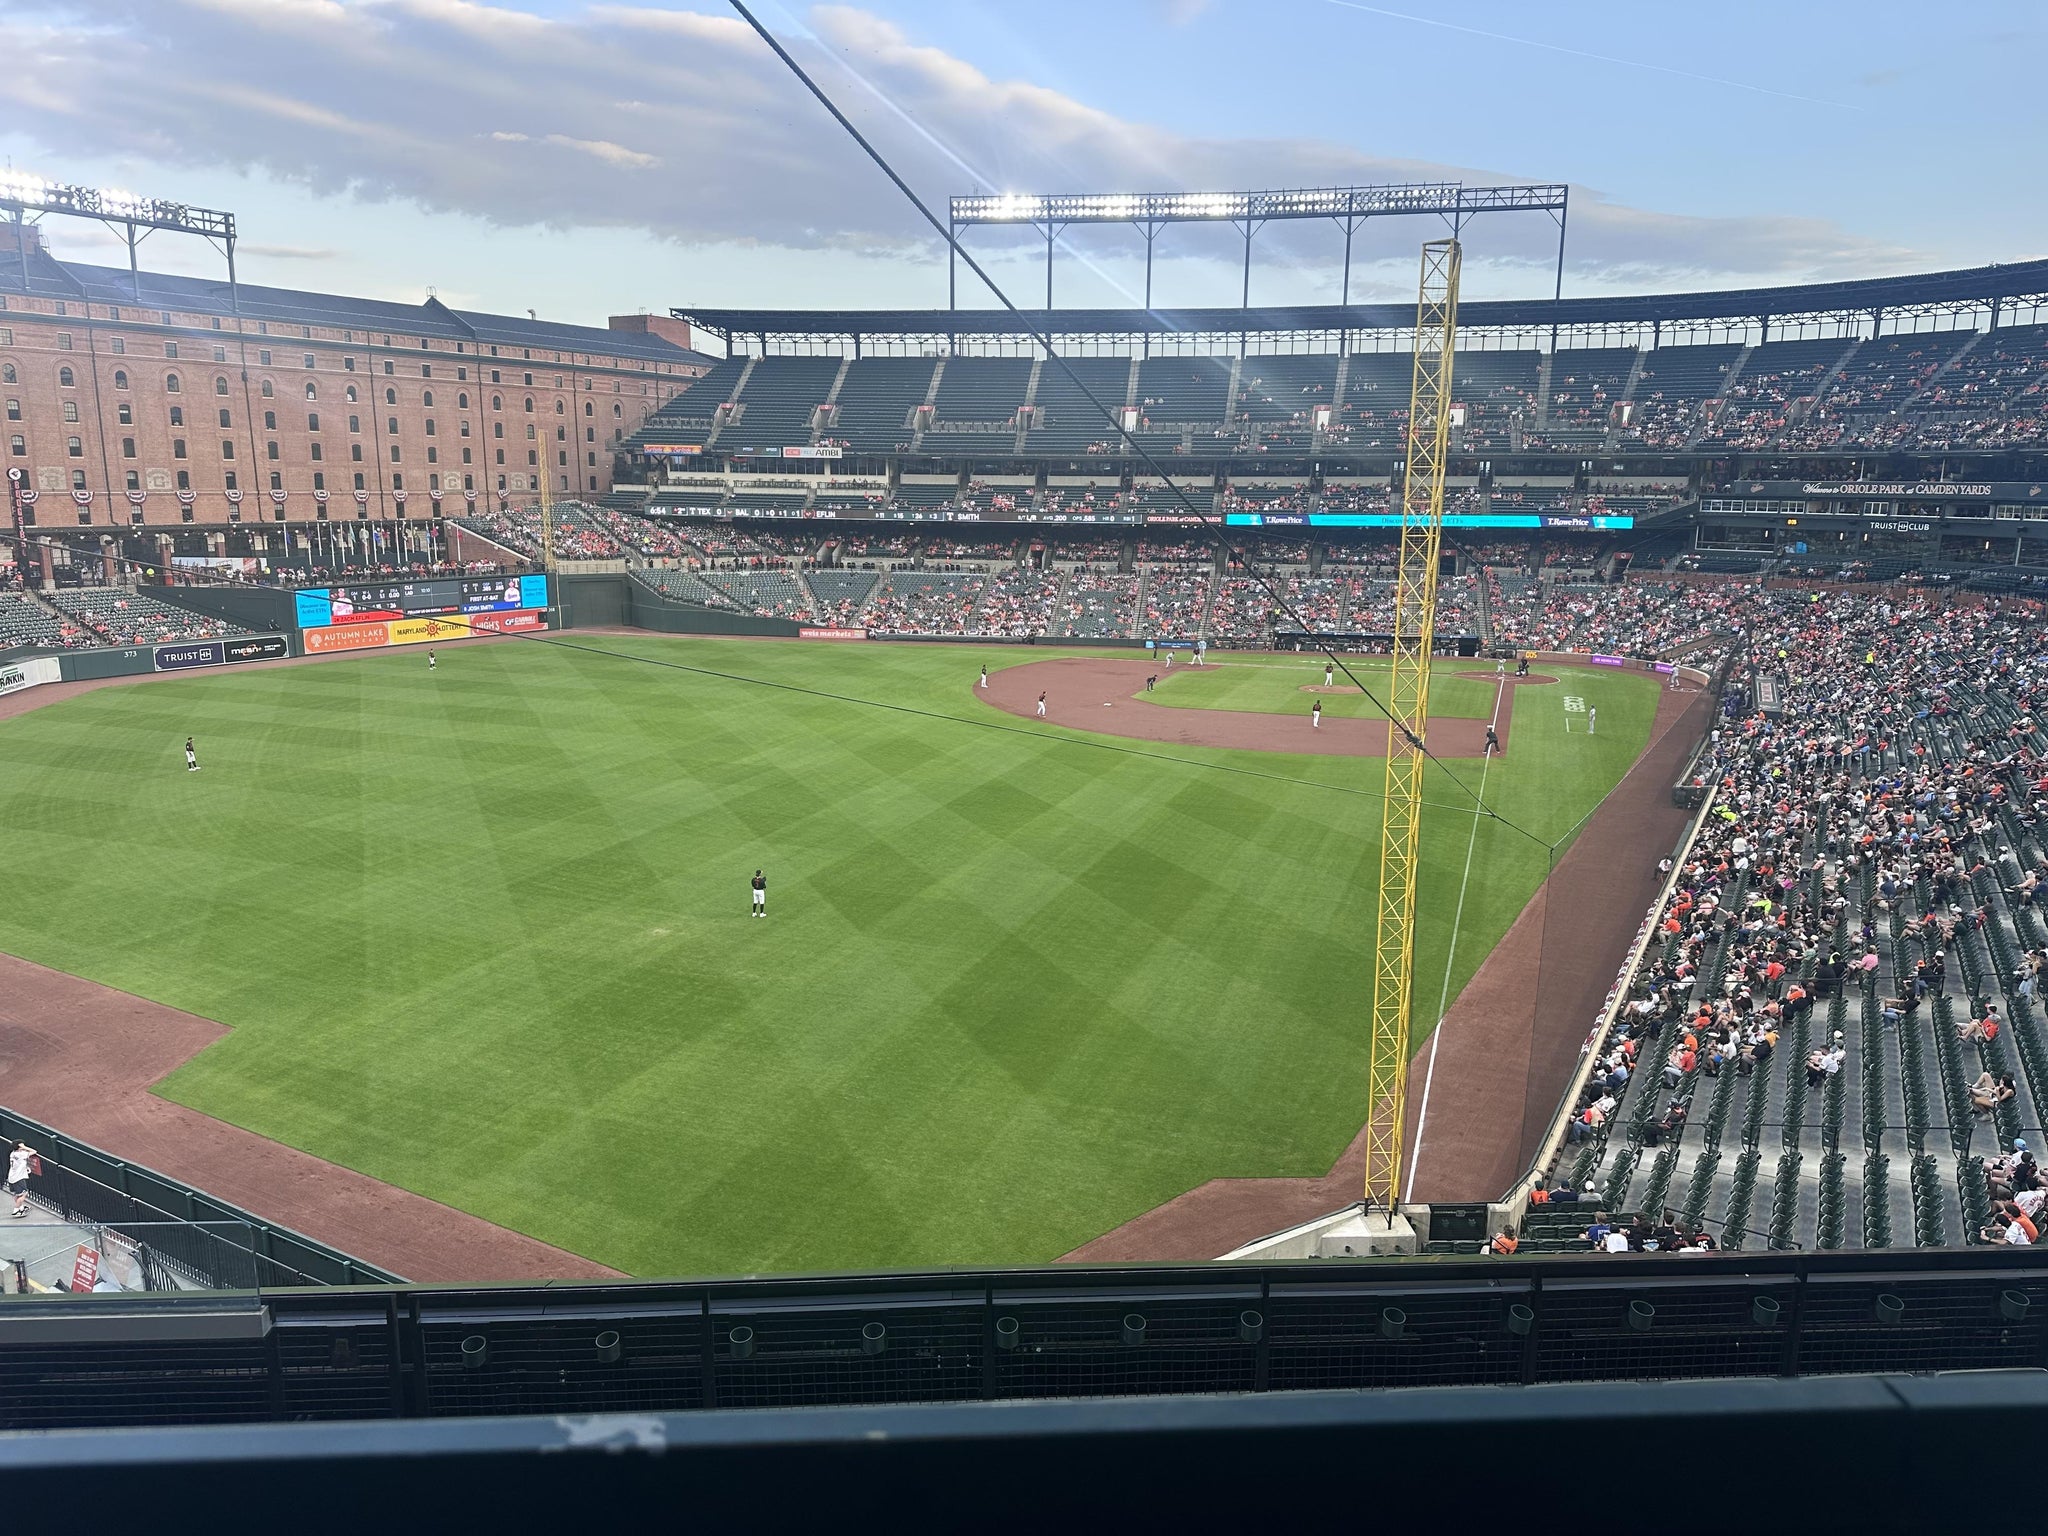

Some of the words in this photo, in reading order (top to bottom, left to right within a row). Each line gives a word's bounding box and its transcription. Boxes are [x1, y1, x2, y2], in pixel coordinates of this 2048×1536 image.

[1802, 483, 1832, 494] Welcome
[1840, 484, 1878, 494] ORIOLE
[1879, 485, 1905, 494] PARK
[1915, 485, 1958, 494] CAMDEN
[1960, 485, 1991, 495] YARDS
[650, 507, 666, 515] 6:54
[735, 508, 749, 516] BAL
[1909, 523, 1930, 531] CLUB
[476, 621, 500, 632] HIGH'S
[324, 631, 360, 641] AUTUMN
[363, 628, 384, 637] LAKE
[164, 651, 198, 662] TRUIST
